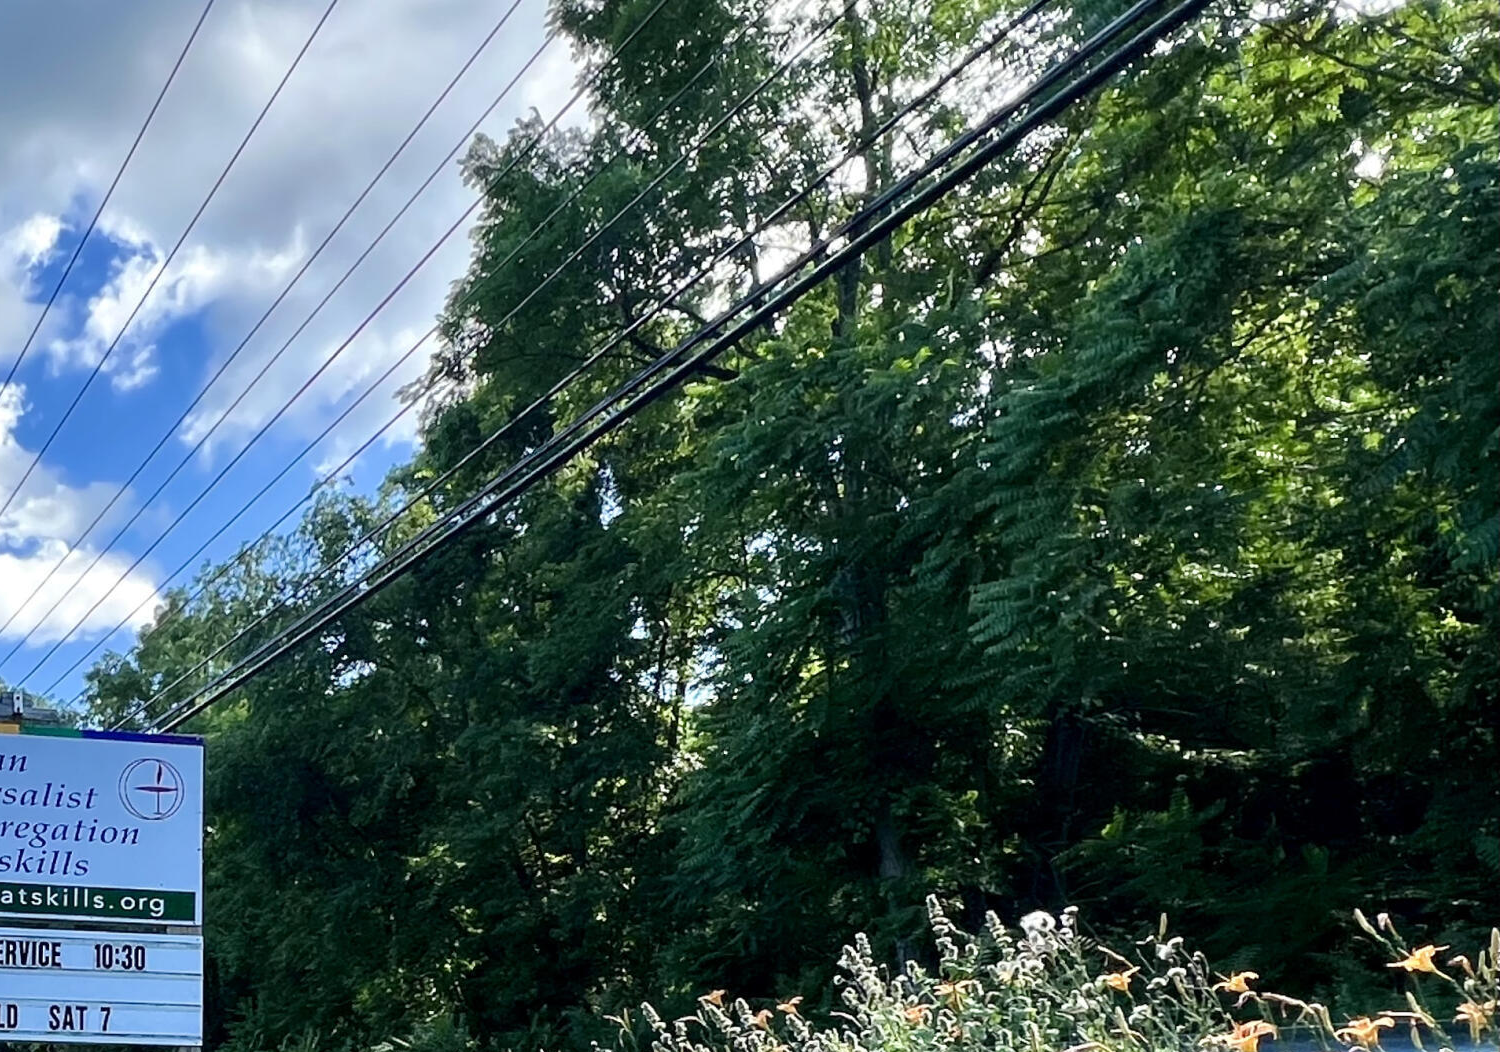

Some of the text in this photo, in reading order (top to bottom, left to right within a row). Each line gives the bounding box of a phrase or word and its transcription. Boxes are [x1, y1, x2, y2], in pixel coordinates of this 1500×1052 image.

[94, 943, 146, 971] 10:30
[48, 1004, 88, 1031] SAT
[100, 1006, 111, 1032] 7
